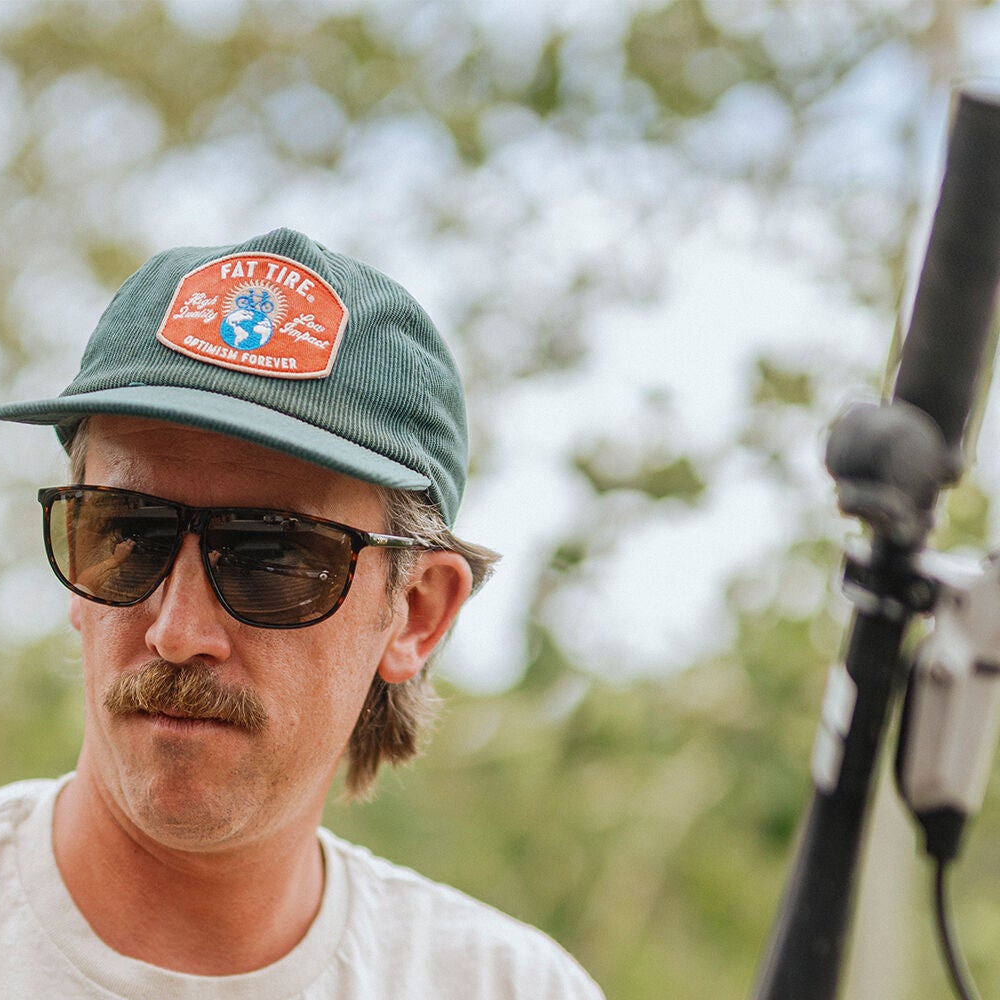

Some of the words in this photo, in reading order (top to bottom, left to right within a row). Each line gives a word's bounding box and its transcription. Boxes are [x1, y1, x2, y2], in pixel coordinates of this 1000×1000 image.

[220, 261, 259, 280] FAT
[184, 292, 219, 310] High
[172, 306, 219, 323] Quality
[293, 313, 326, 332] Low
[279, 322, 330, 349] Impact
[183, 335, 239, 360] OPTIMISM
[241, 352, 297, 369] FOREVER
